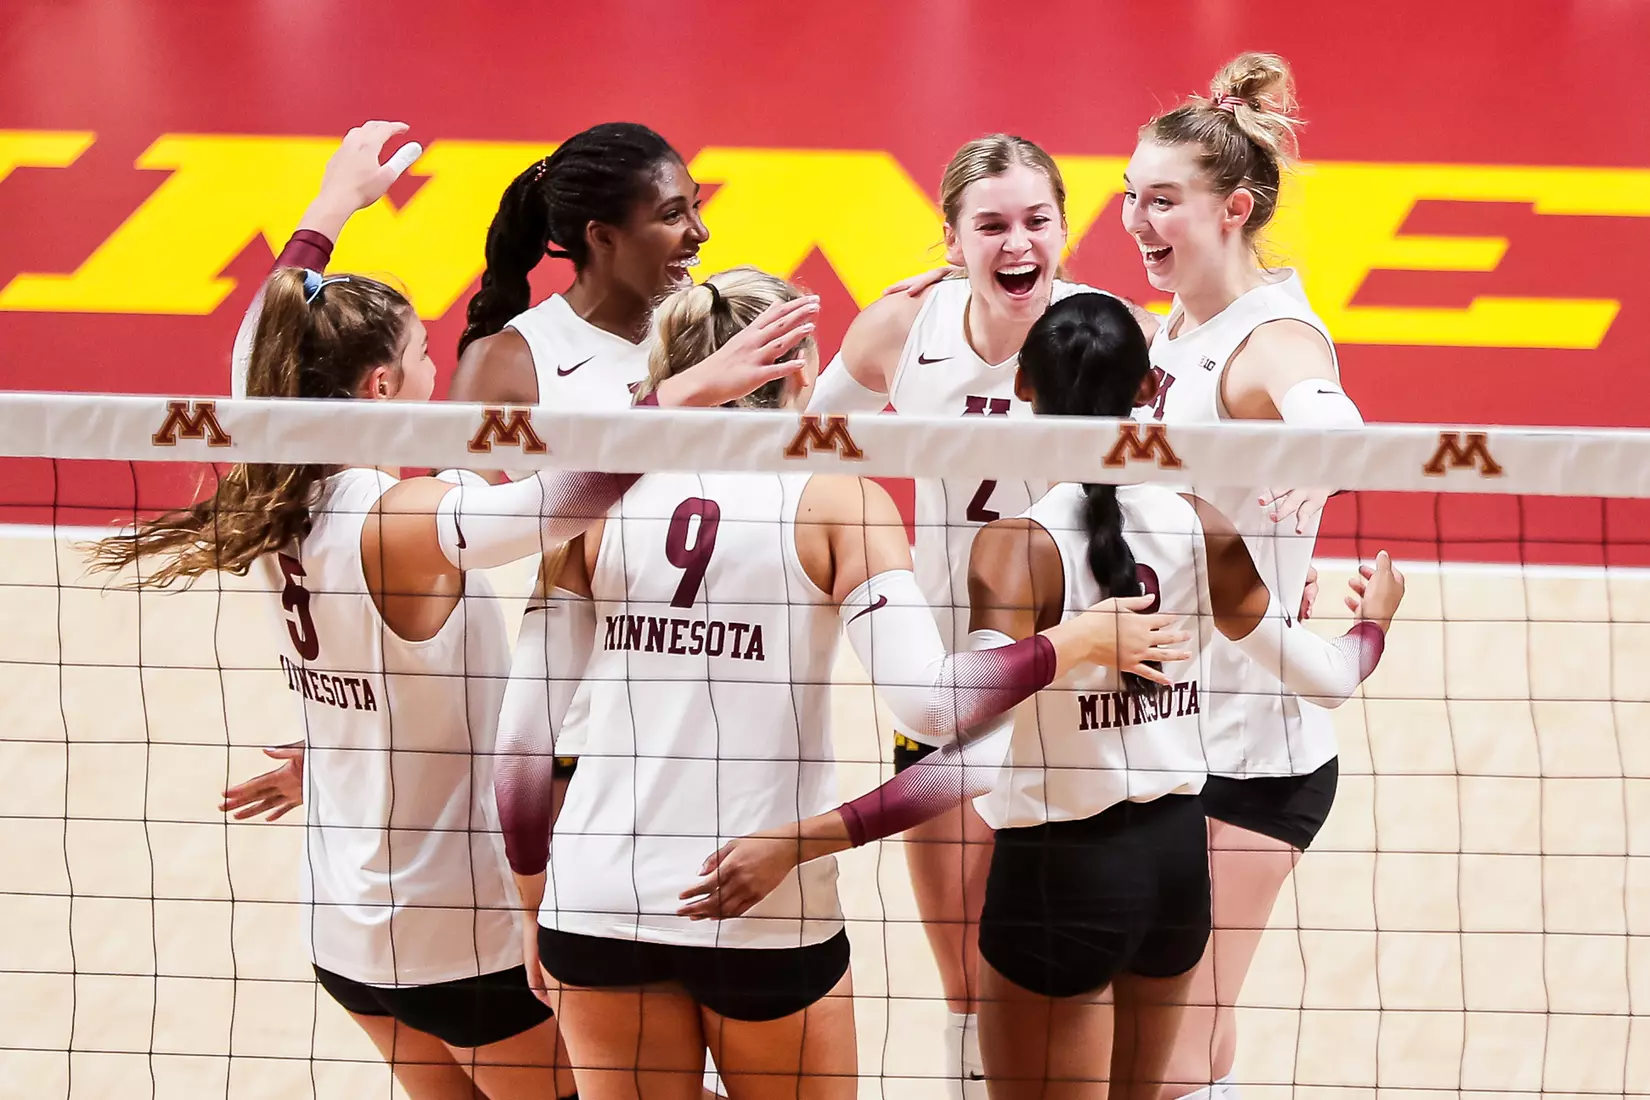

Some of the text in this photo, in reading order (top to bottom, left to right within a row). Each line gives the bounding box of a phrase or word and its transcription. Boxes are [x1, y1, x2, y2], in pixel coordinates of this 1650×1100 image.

[153, 400, 231, 447] M
[468, 406, 547, 454] M
[785, 414, 863, 460] M
[1103, 423, 1183, 469] M
[1424, 431, 1503, 478] M
[666, 497, 720, 608] 9
[278, 552, 319, 661] 5
[604, 615, 765, 661] MINNESOTA
